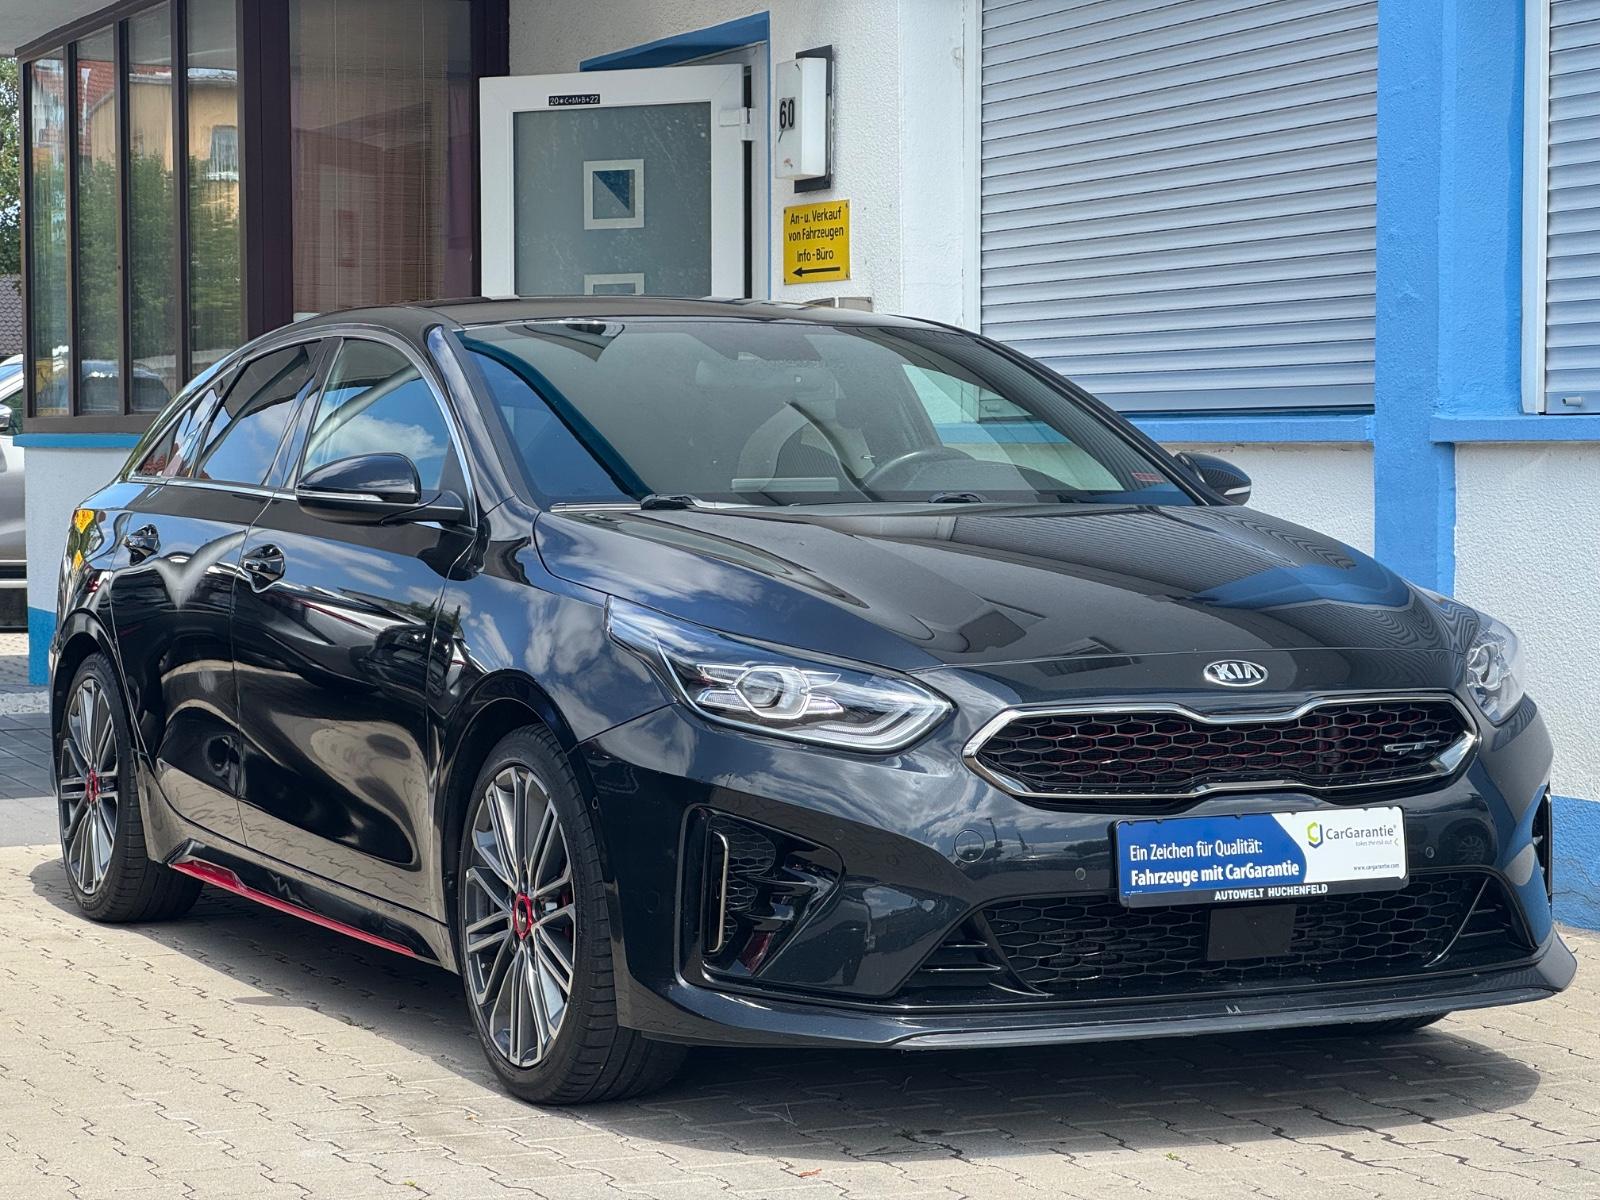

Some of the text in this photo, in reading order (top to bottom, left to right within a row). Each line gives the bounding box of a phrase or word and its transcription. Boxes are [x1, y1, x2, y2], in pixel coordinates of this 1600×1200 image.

[779, 99, 795, 129] 60
[812, 206, 841, 222] Verkauf
[788, 226, 844, 242] von Fahrzeugen
[1212, 663, 1261, 680] KIA
[1129, 838, 1263, 861] Ein Zeichen für Qualität:
[1131, 860, 1299, 887] Fahrzeuge mit CarGarantie
[1214, 883, 1328, 901] AUTOWELT HUCHENFELD
